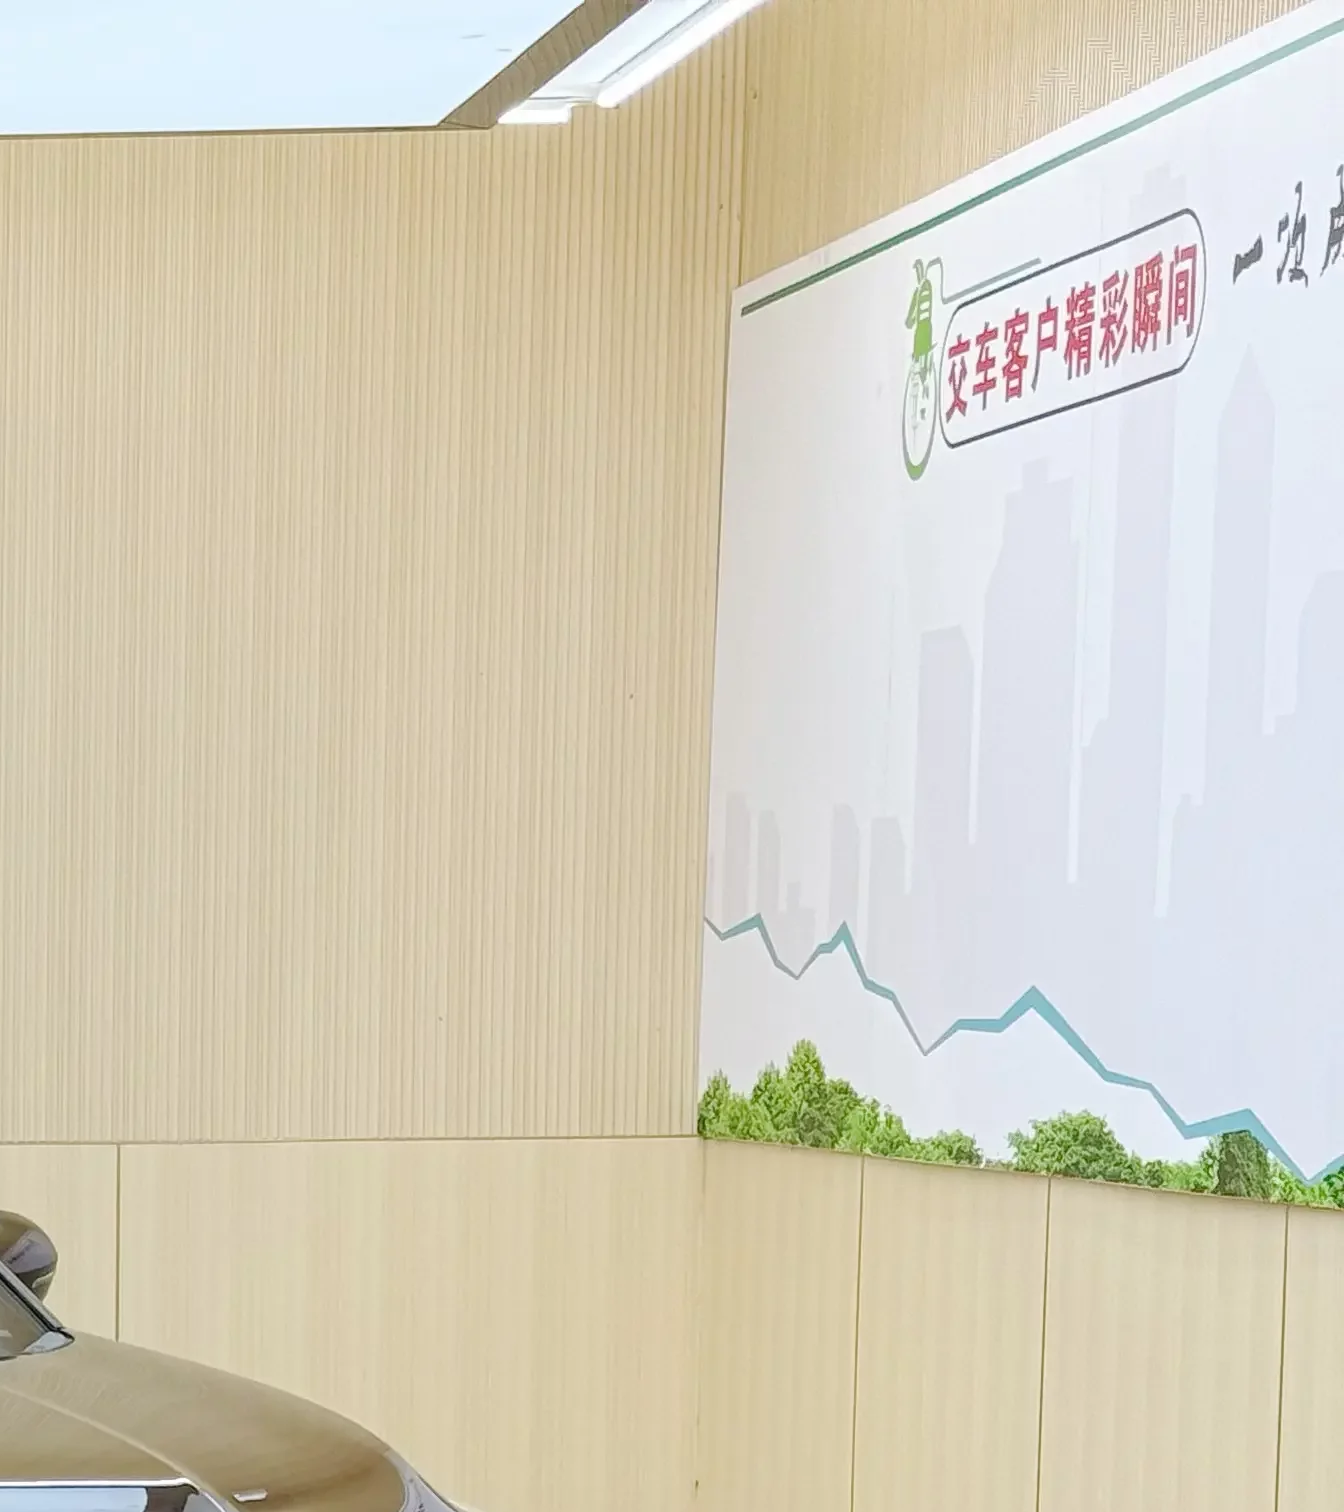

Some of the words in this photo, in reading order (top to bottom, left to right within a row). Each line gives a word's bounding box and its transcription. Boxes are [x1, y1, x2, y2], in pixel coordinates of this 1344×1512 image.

[945, 243, 1199, 423] 交车客户精彩瞬间
